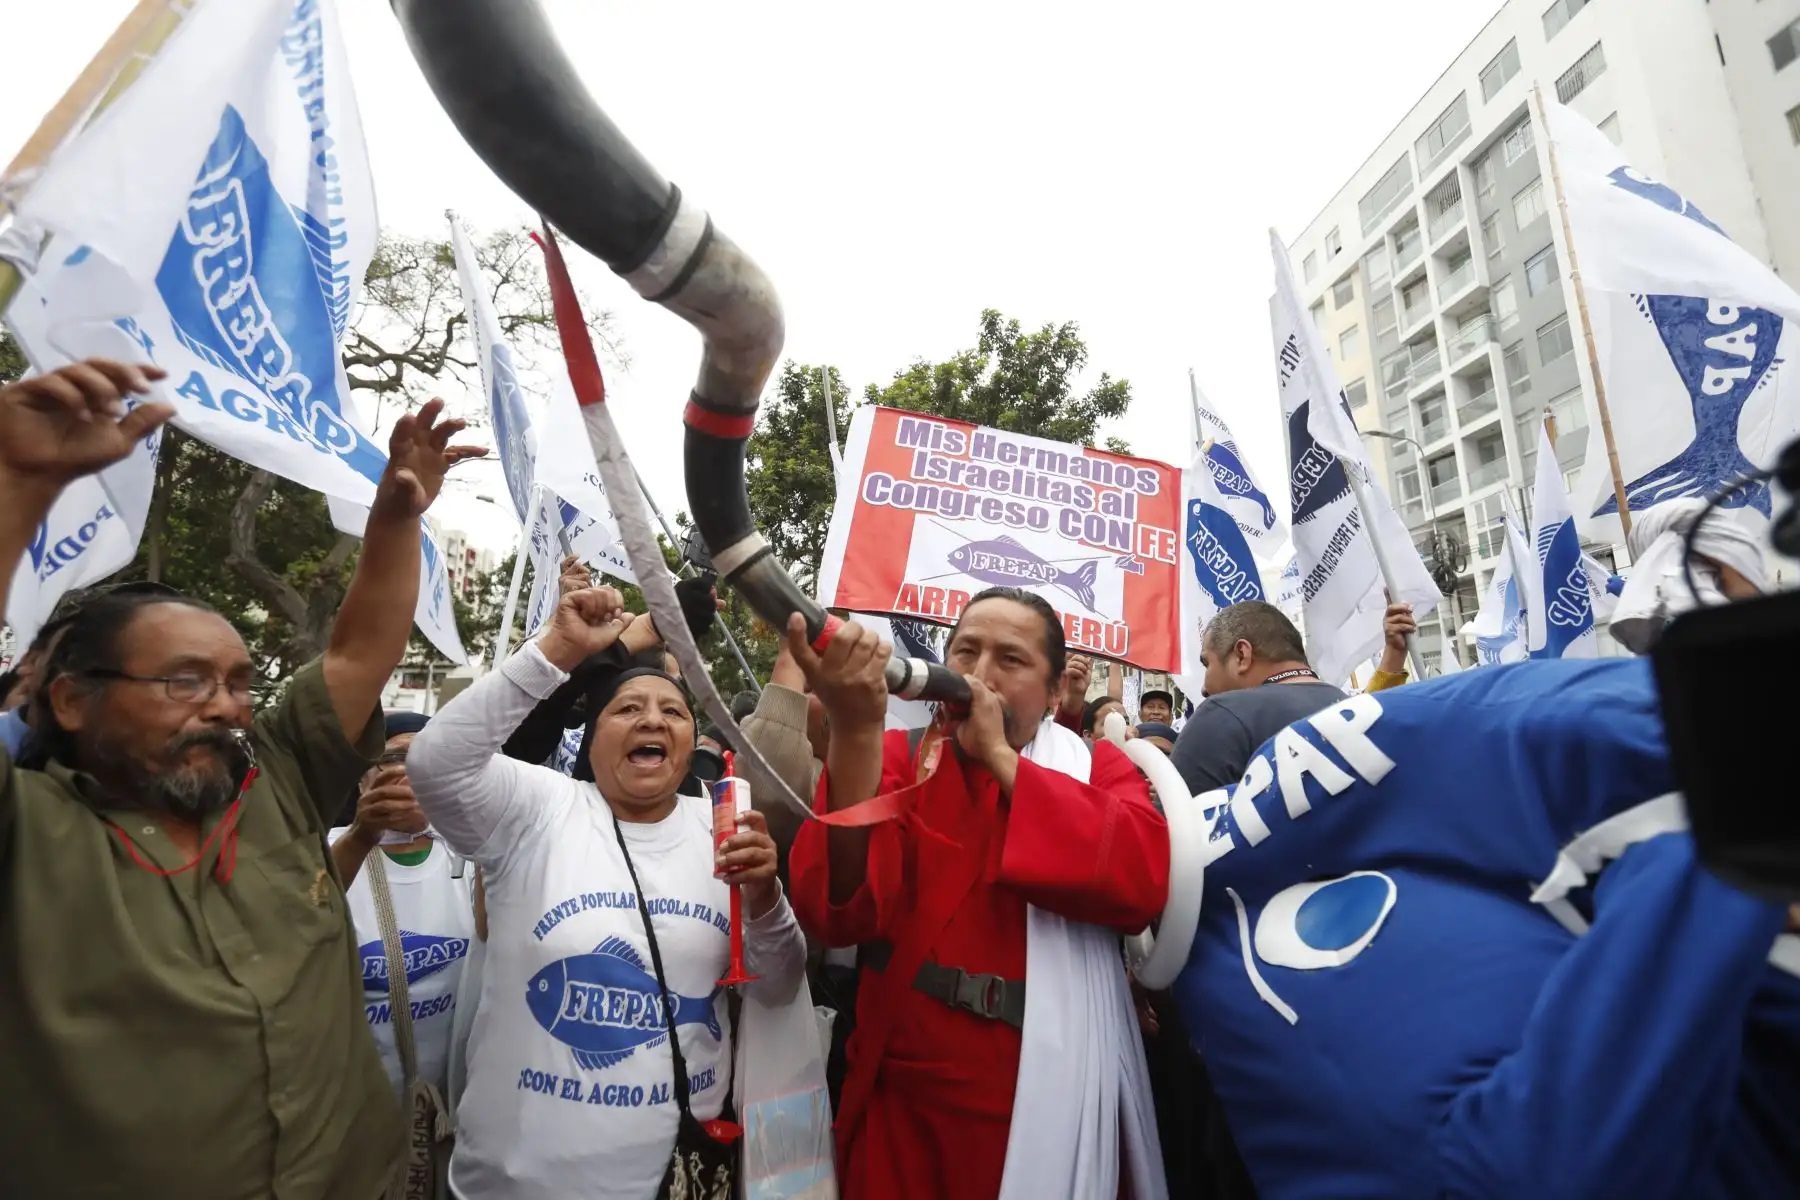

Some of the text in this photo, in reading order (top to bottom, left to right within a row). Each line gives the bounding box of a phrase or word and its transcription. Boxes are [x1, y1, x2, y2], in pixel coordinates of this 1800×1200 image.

[185, 177, 357, 455] FREPAP
[174, 370, 333, 455] AGR
[897, 417, 1160, 496] Mis Hermanos
[911, 449, 1139, 521] Israelitas al
[863, 472, 1178, 565] Congreso CON FE
[1237, 521, 1264, 538] ODER!
[971, 551, 1059, 583] FREPAP
[893, 582, 1129, 657] ARR ERÚ
[1268, 670, 1299, 682] DIGITAL
[1193, 692, 1398, 868] EPAP
[532, 898, 580, 942] FRENTE
[580, 890, 637, 910] POPULAR
[646, 897, 691, 917] RICOLA
[692, 903, 712, 923] FIA
[517, 1067, 559, 1097] ¡CON
[559, 1078, 584, 1103] EL
[586, 1083, 644, 1107] AGRO
[647, 1082, 670, 1106] AL
